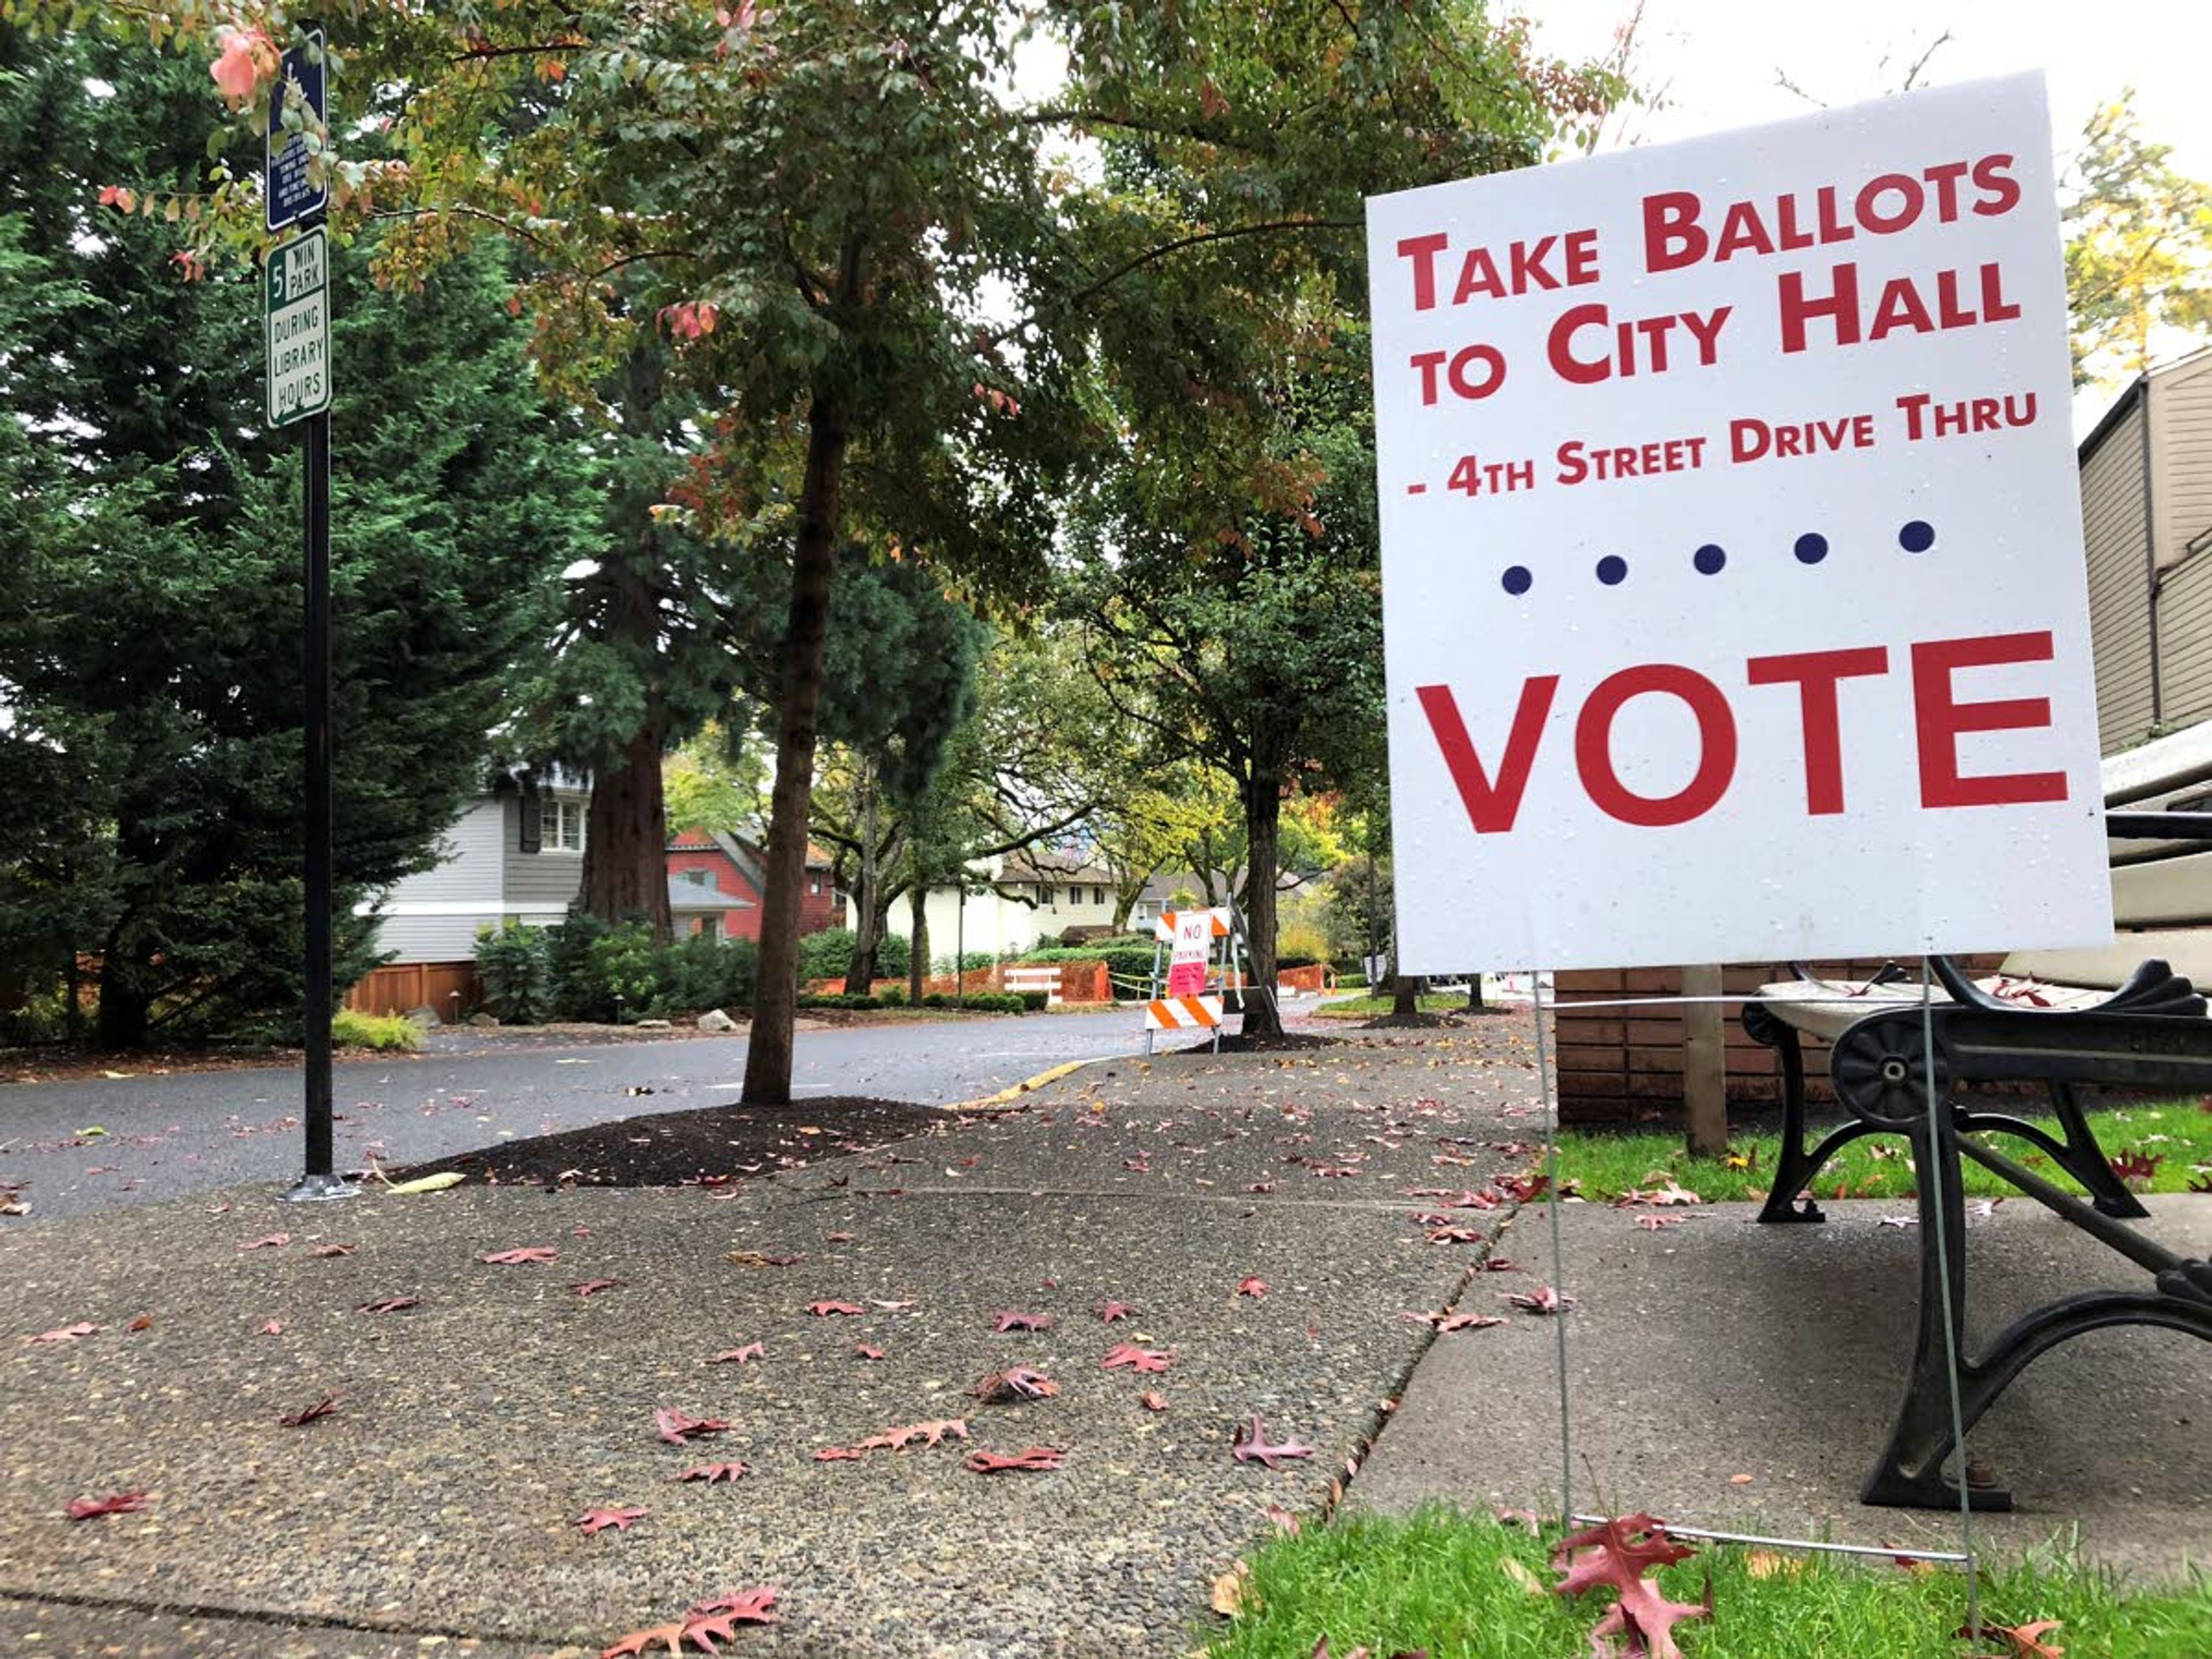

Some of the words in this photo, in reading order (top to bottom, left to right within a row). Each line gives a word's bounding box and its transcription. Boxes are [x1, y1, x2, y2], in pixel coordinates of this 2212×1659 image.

[1397, 230, 1599, 310] TAKE
[1643, 154, 2020, 274] BALLOTS
[293, 240, 314, 270] MIN
[274, 265, 283, 298] 5
[289, 264, 320, 297] PARK
[275, 306, 318, 343] DURING
[1410, 344, 1506, 406] TO
[1547, 304, 1730, 384] CITY
[1779, 263, 2021, 354] HALL
[275, 338, 323, 377] LIBRARY
[279, 372, 319, 408] HOURS
[1448, 456, 1535, 497] 4TH
[1556, 438, 1705, 485] STREET
[1730, 416, 1873, 463] DRIVE
[1897, 394, 2036, 440] THRU
[1416, 631, 2069, 834] VOTE
[1184, 924, 1201, 940] NO
